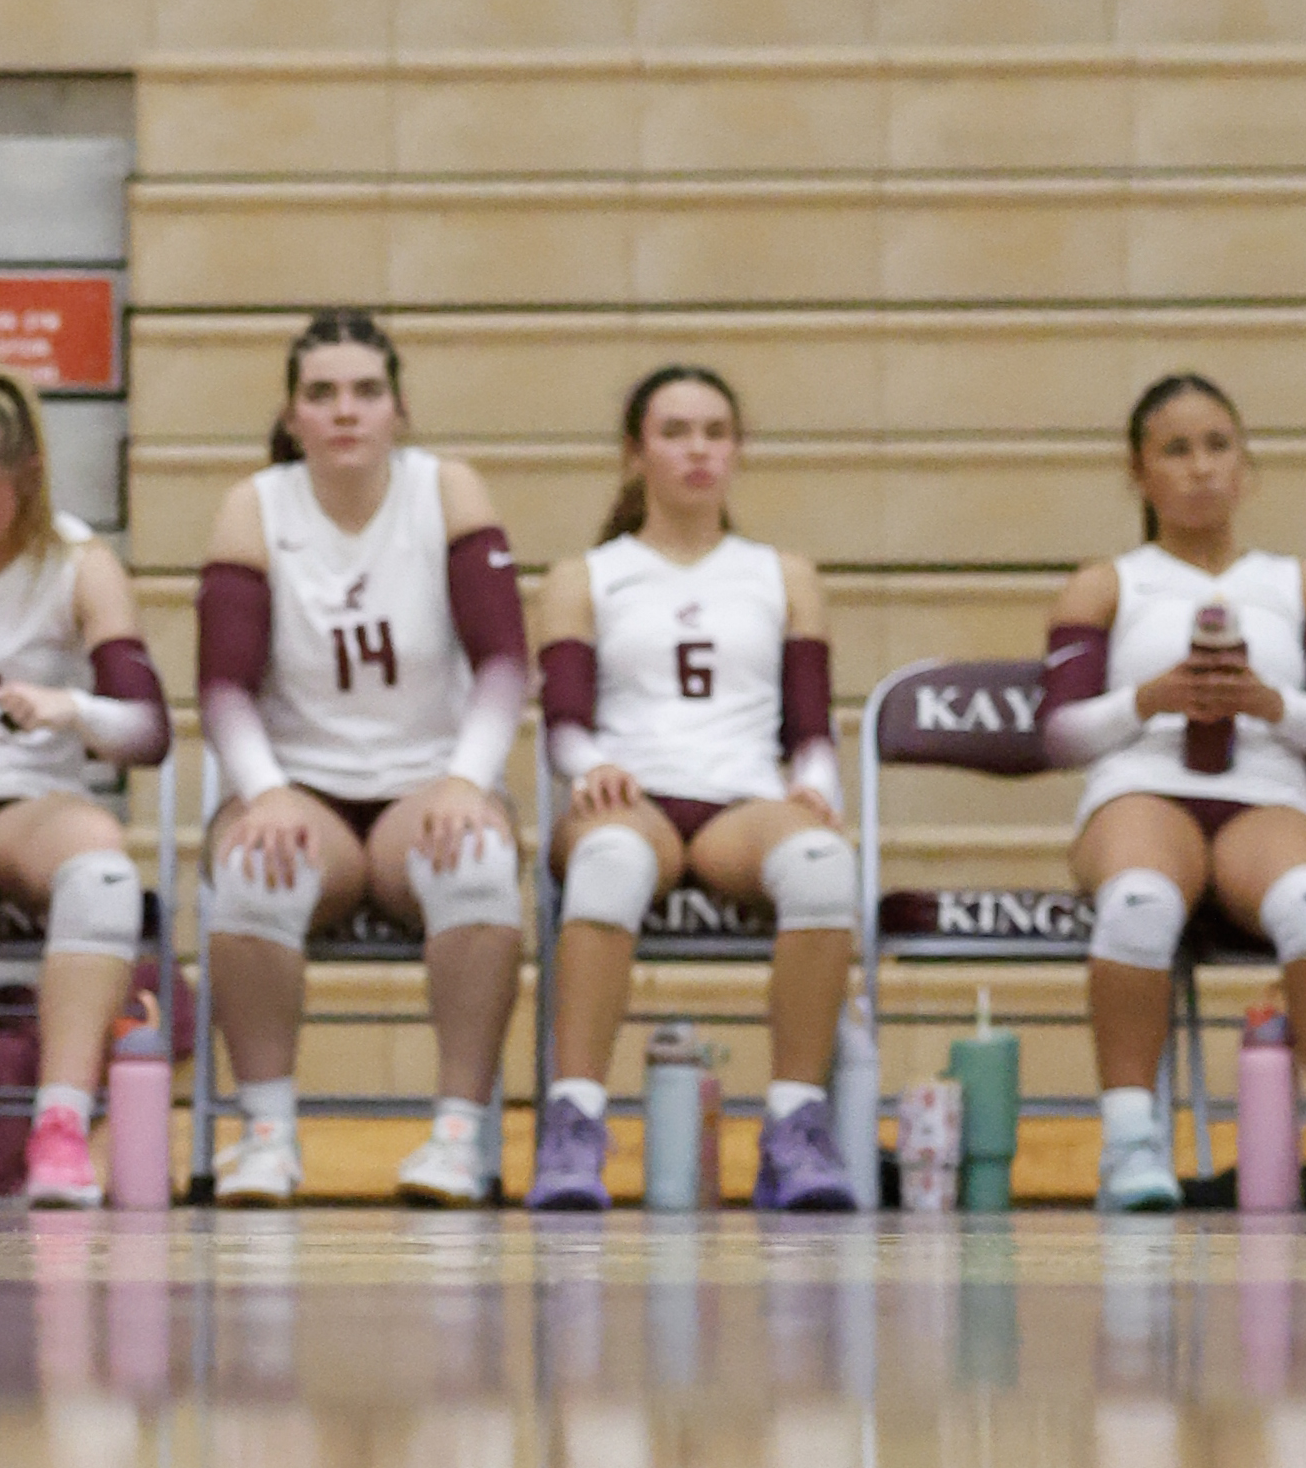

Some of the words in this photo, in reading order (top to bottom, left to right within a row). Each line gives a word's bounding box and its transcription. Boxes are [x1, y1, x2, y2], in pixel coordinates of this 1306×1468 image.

[332, 618, 396, 691] 14
[676, 642, 713, 698] 6
[916, 686, 1046, 732] KAY
